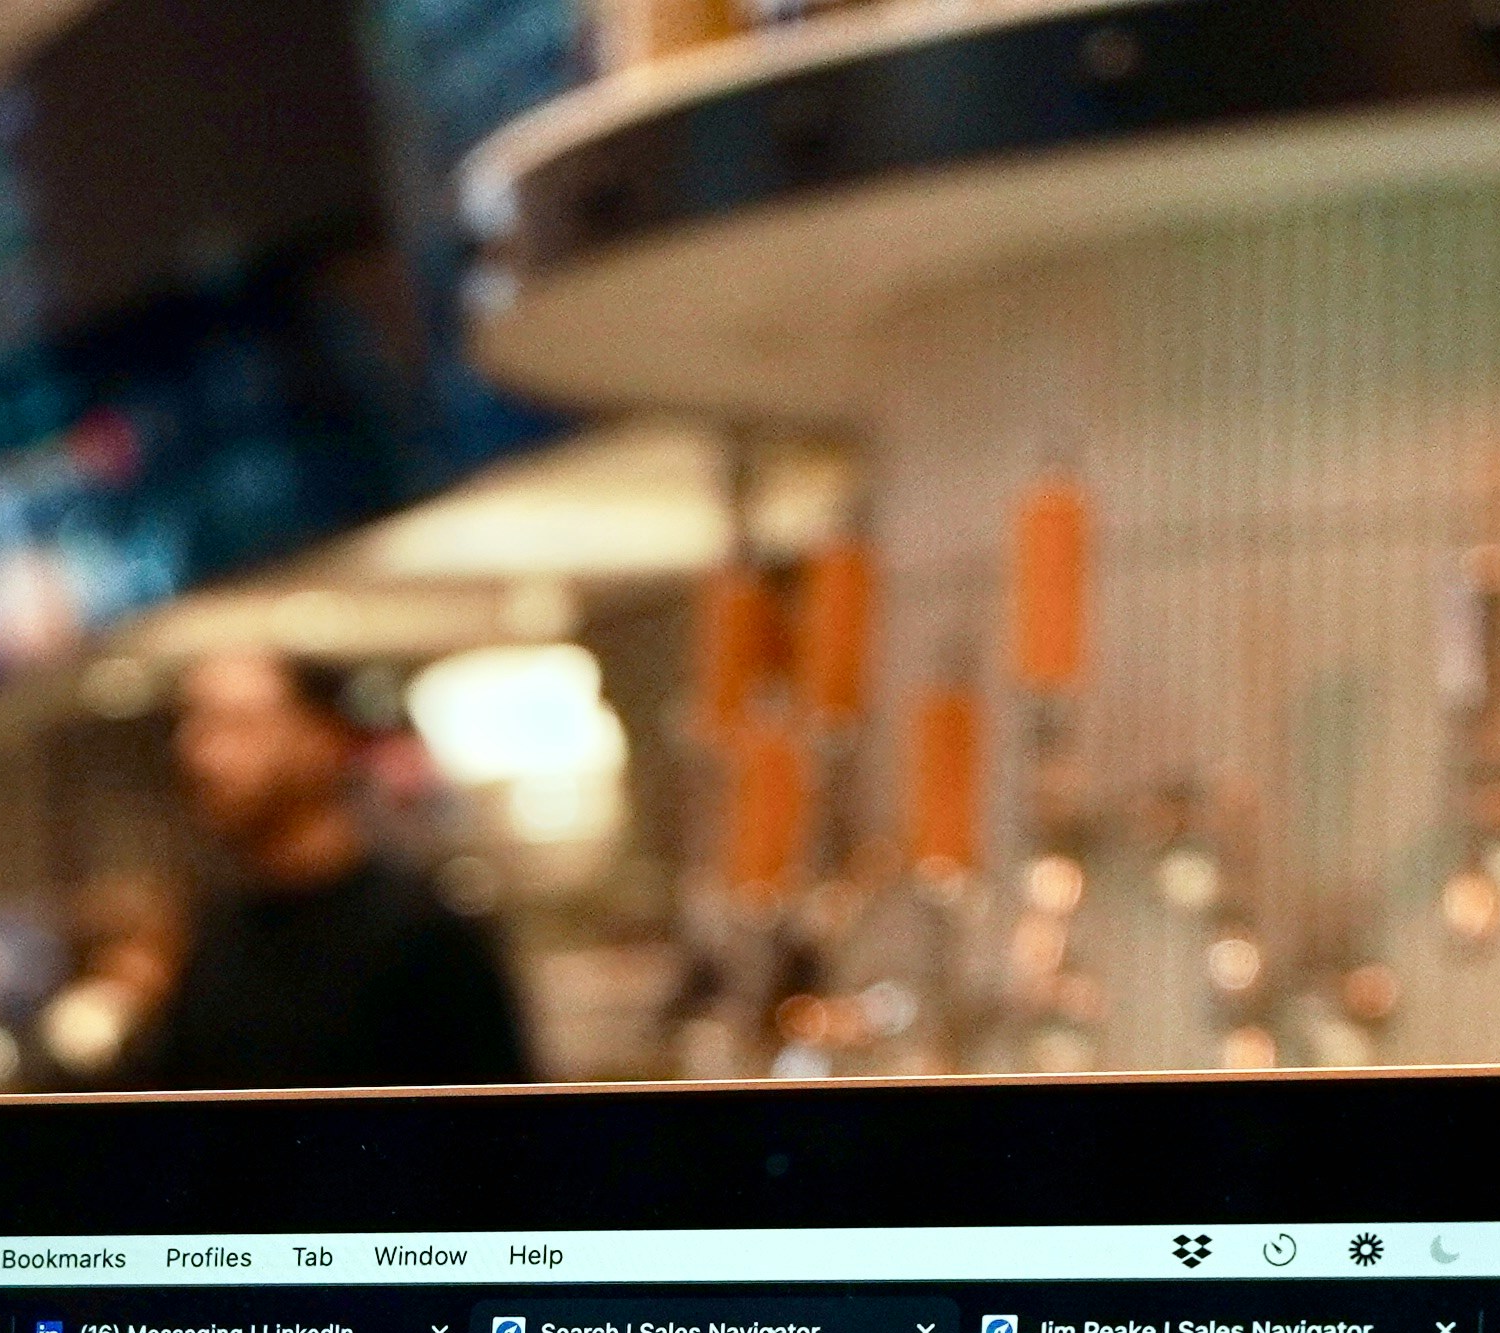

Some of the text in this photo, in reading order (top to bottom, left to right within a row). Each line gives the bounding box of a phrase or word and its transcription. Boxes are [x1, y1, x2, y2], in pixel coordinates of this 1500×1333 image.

[1, 1247, 126, 1269] Bookmarks
[166, 1246, 252, 1268] Profiles
[292, 1245, 333, 1267] Tab
[374, 1244, 468, 1267] Window
[509, 1243, 564, 1270] Help
